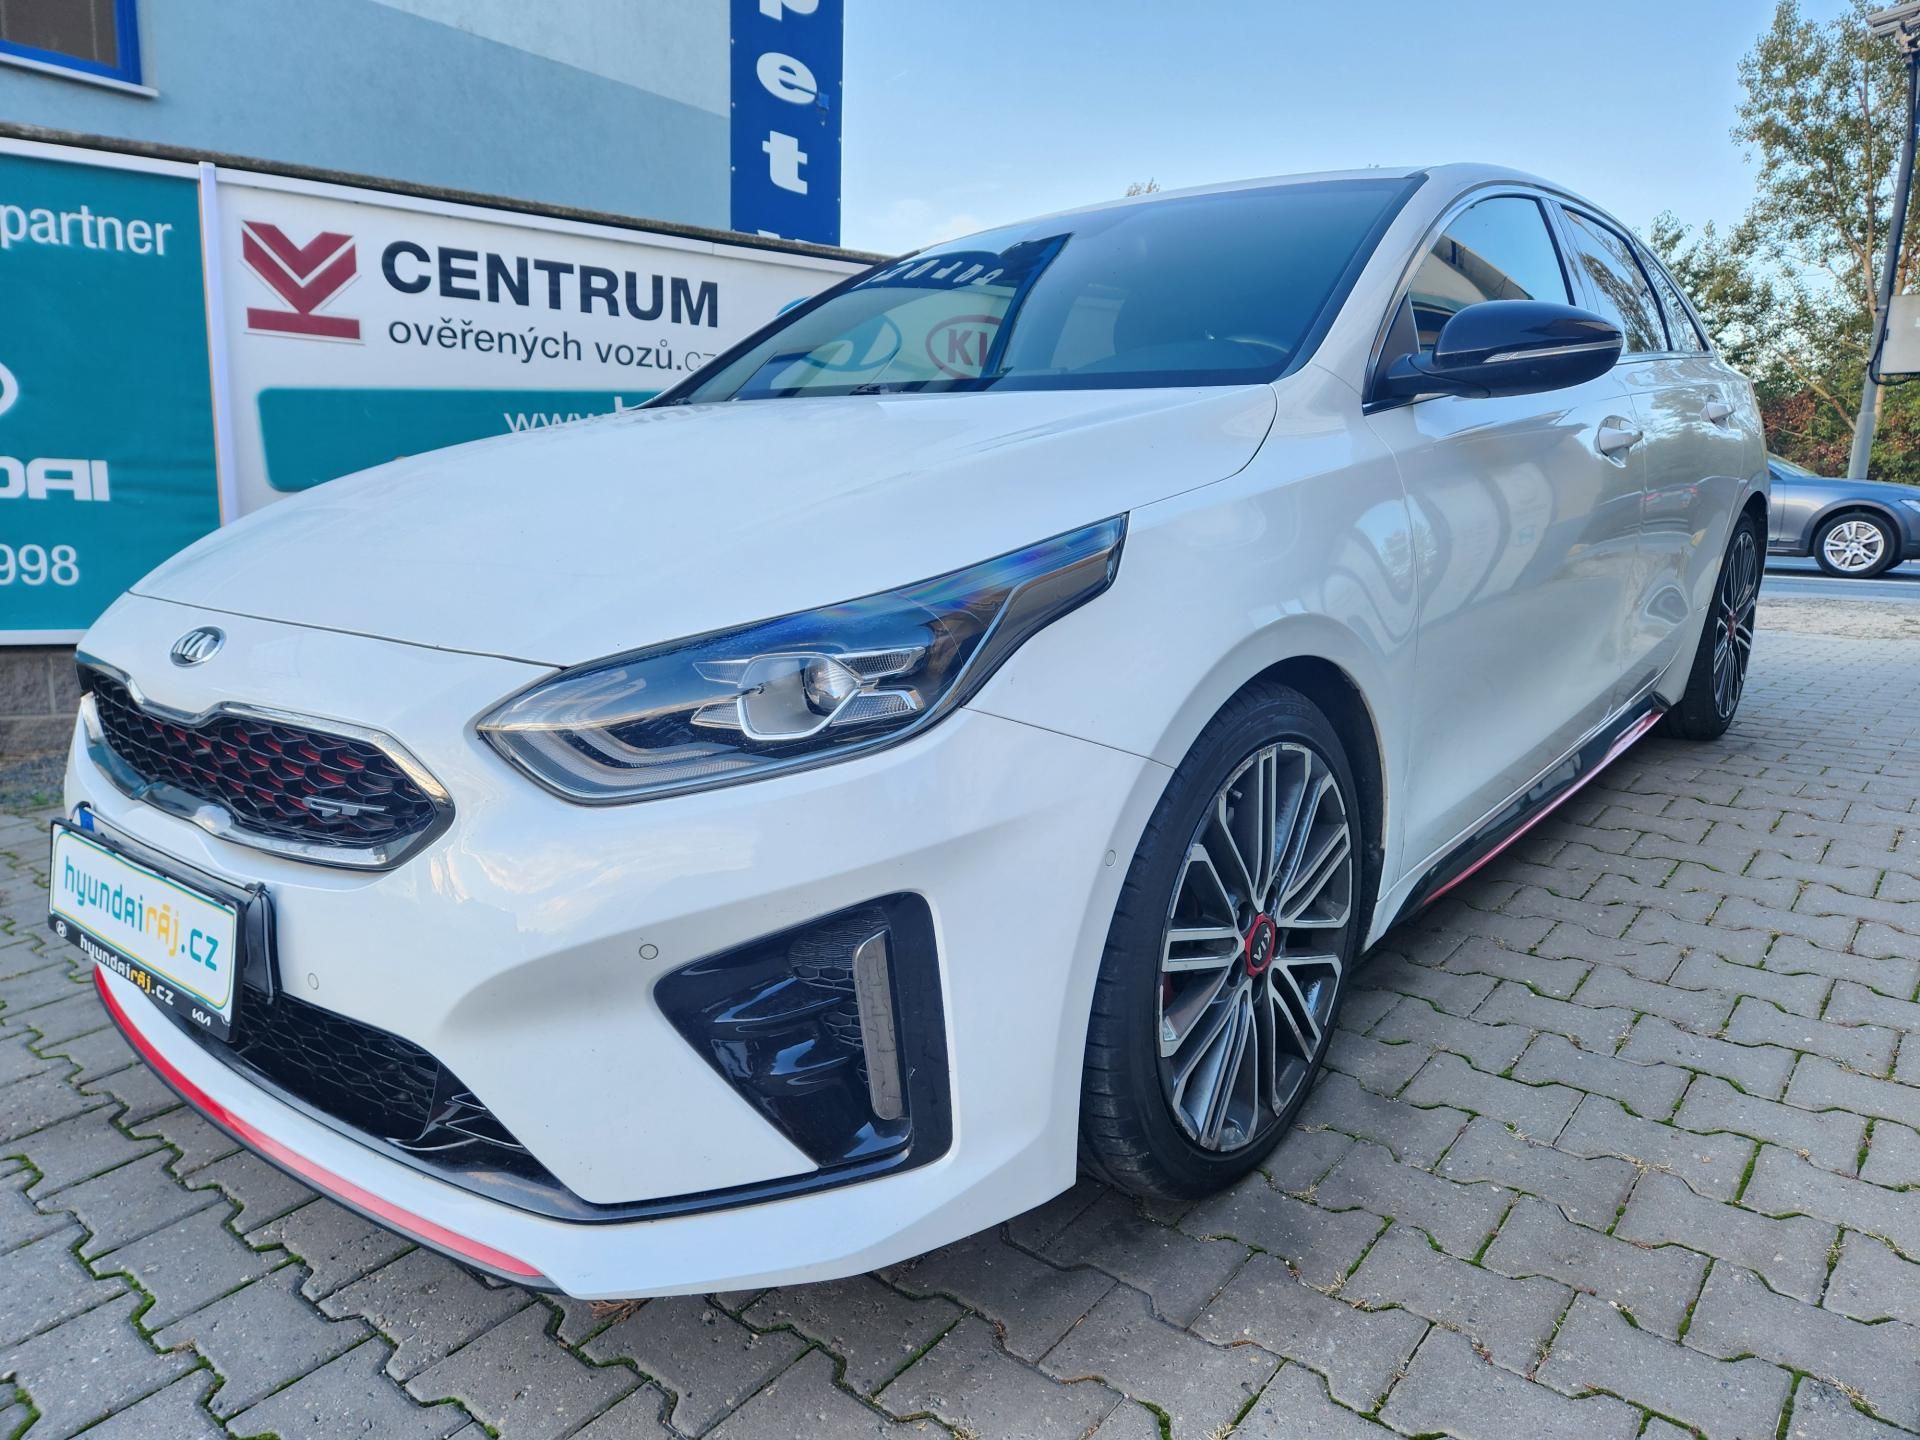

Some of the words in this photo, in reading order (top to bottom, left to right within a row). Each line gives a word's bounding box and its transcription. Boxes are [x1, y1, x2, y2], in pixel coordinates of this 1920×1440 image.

[0, 205, 173, 256] partner
[380, 240, 720, 329] CENTRUM
[388, 318, 583, 364] ověřených
[594, 338, 717, 372] vozů.c
